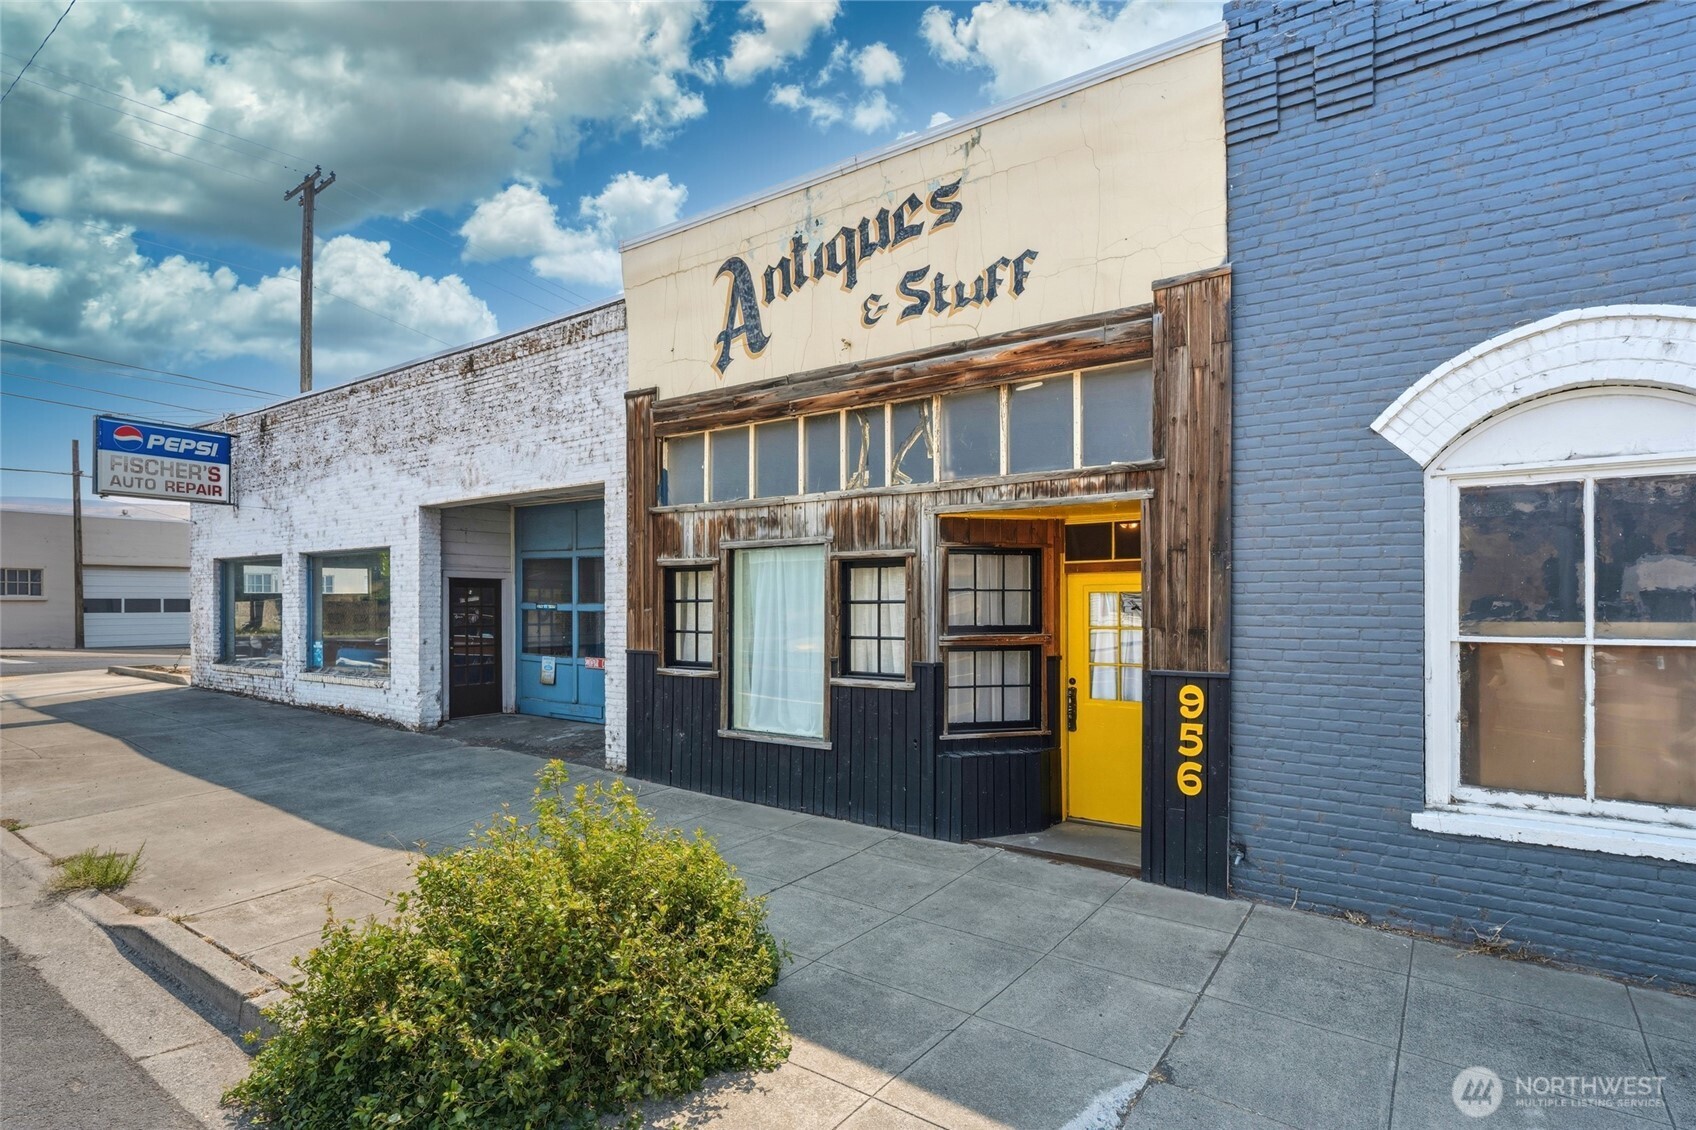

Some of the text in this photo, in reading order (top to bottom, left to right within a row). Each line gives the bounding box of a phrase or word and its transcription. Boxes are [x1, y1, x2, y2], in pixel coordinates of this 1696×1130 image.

[711, 176, 964, 380] Antiques
[860, 248, 1039, 330] & Stuff
[110, 454, 221, 483] FISCHER'S
[146, 434, 219, 457] PEPSI
[109, 474, 223, 497] AUTO REPAIR
[1177, 684, 1205, 796] 956
